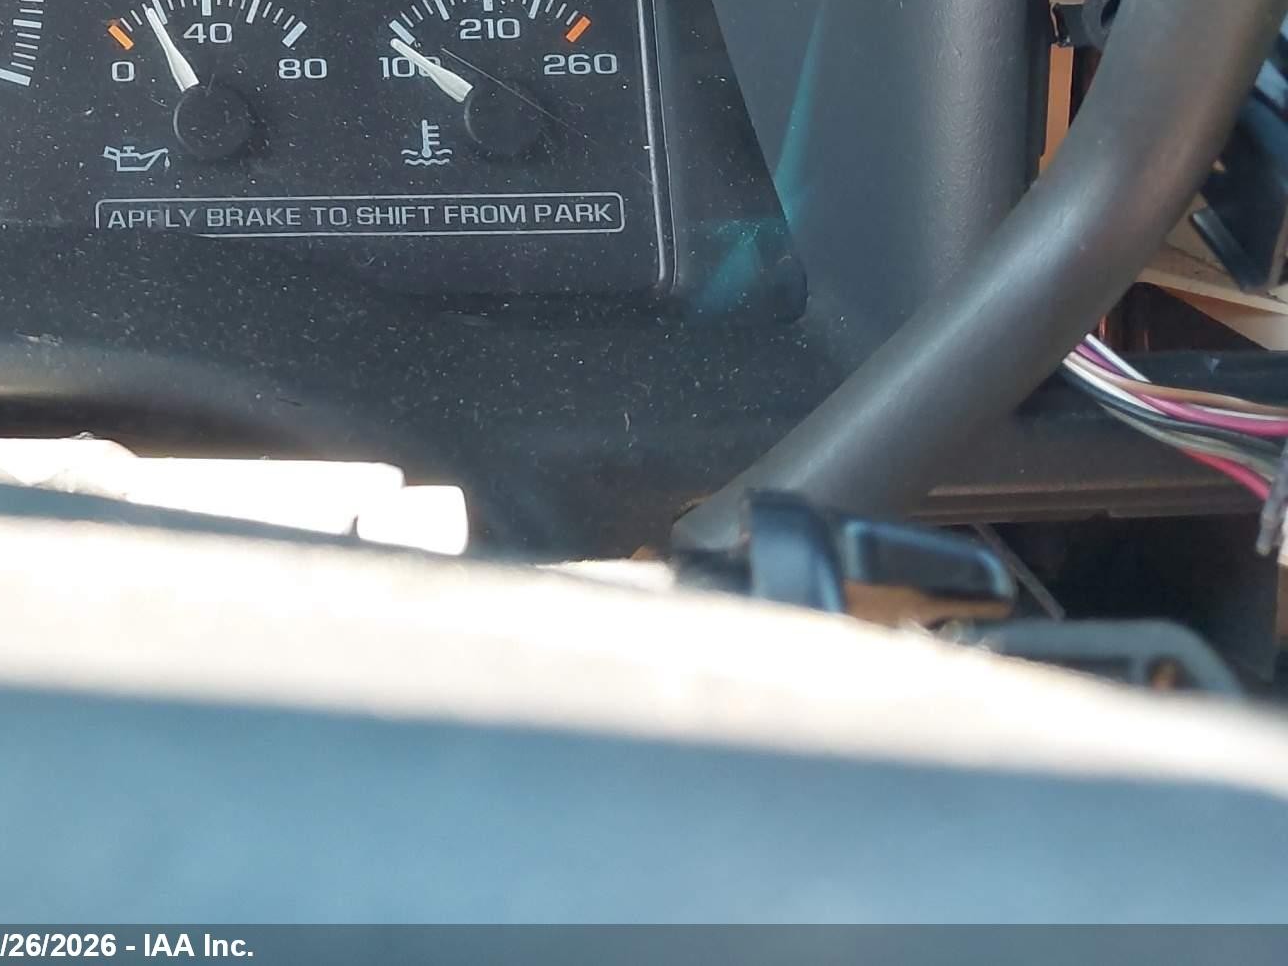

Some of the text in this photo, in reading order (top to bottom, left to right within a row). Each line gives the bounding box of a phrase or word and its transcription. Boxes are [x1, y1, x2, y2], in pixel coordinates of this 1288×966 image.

[184, 23, 232, 43] 40
[460, 19, 519, 39] 210
[112, 62, 134, 81] 0
[279, 59, 327, 78] 80
[544, 54, 617, 74] 260
[207, 207, 301, 226] BRAKE
[311, 207, 347, 225] TO
[357, 206, 434, 224] SHIFT
[445, 205, 526, 223] FROM
[536, 204, 612, 222] PARK
